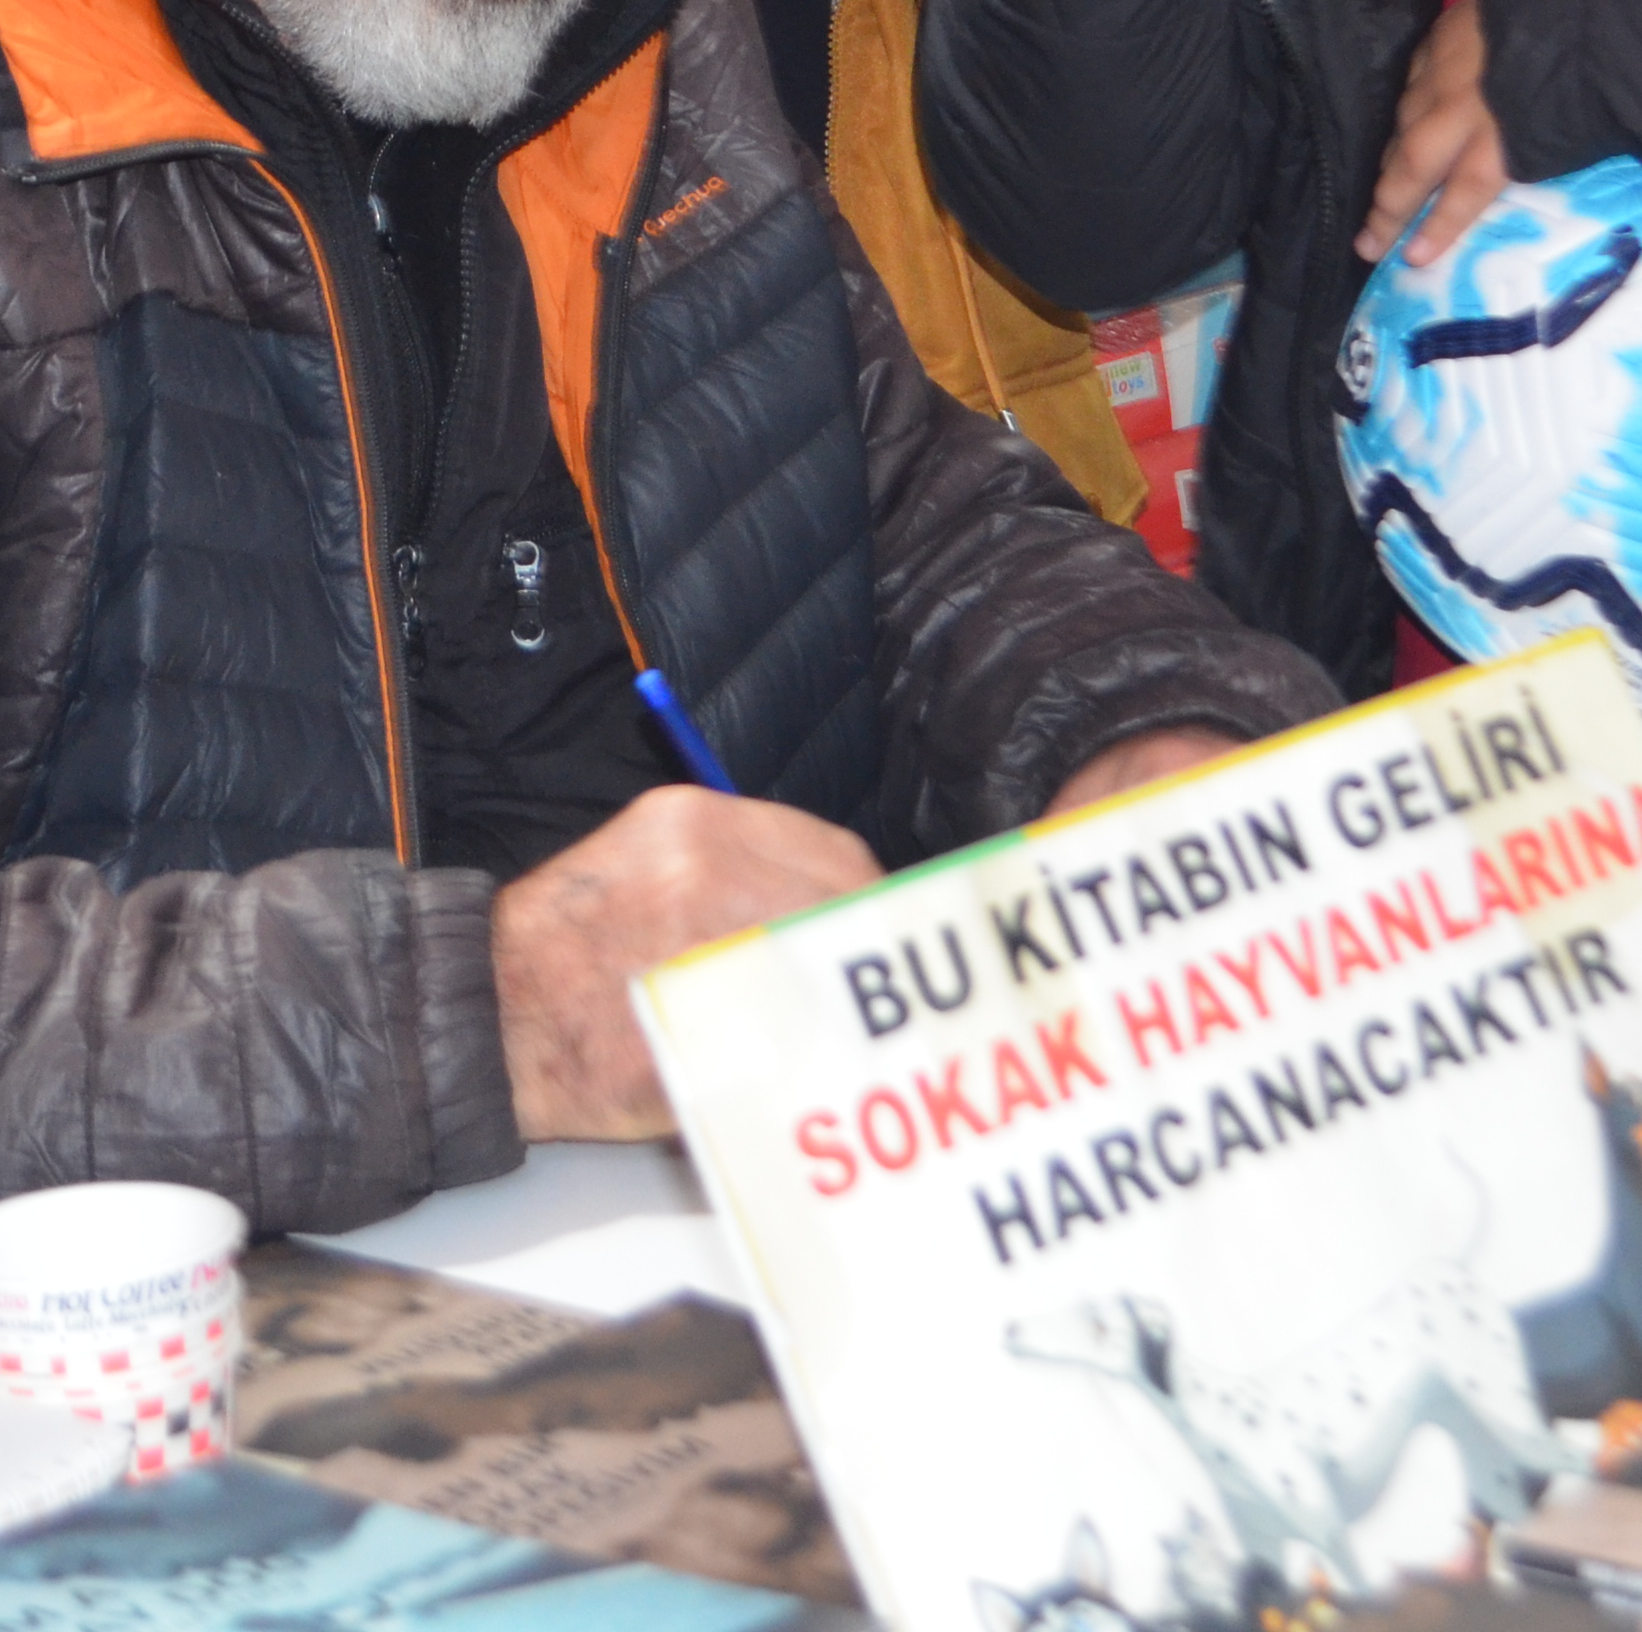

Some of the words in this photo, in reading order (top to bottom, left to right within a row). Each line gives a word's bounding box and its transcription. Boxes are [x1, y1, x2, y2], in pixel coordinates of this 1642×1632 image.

[1109, 360, 1142, 379] new
[1112, 372, 1145, 399] toys
[840, 920, 977, 1042] BU
[987, 798, 1312, 993] KİTABIN
[1323, 684, 1569, 856] GELİRİ
[795, 1013, 1113, 1200] SOKAK
[970, 927, 1633, 1268] HARCANACAKTIR
[99, 1268, 186, 1308] Coffee
